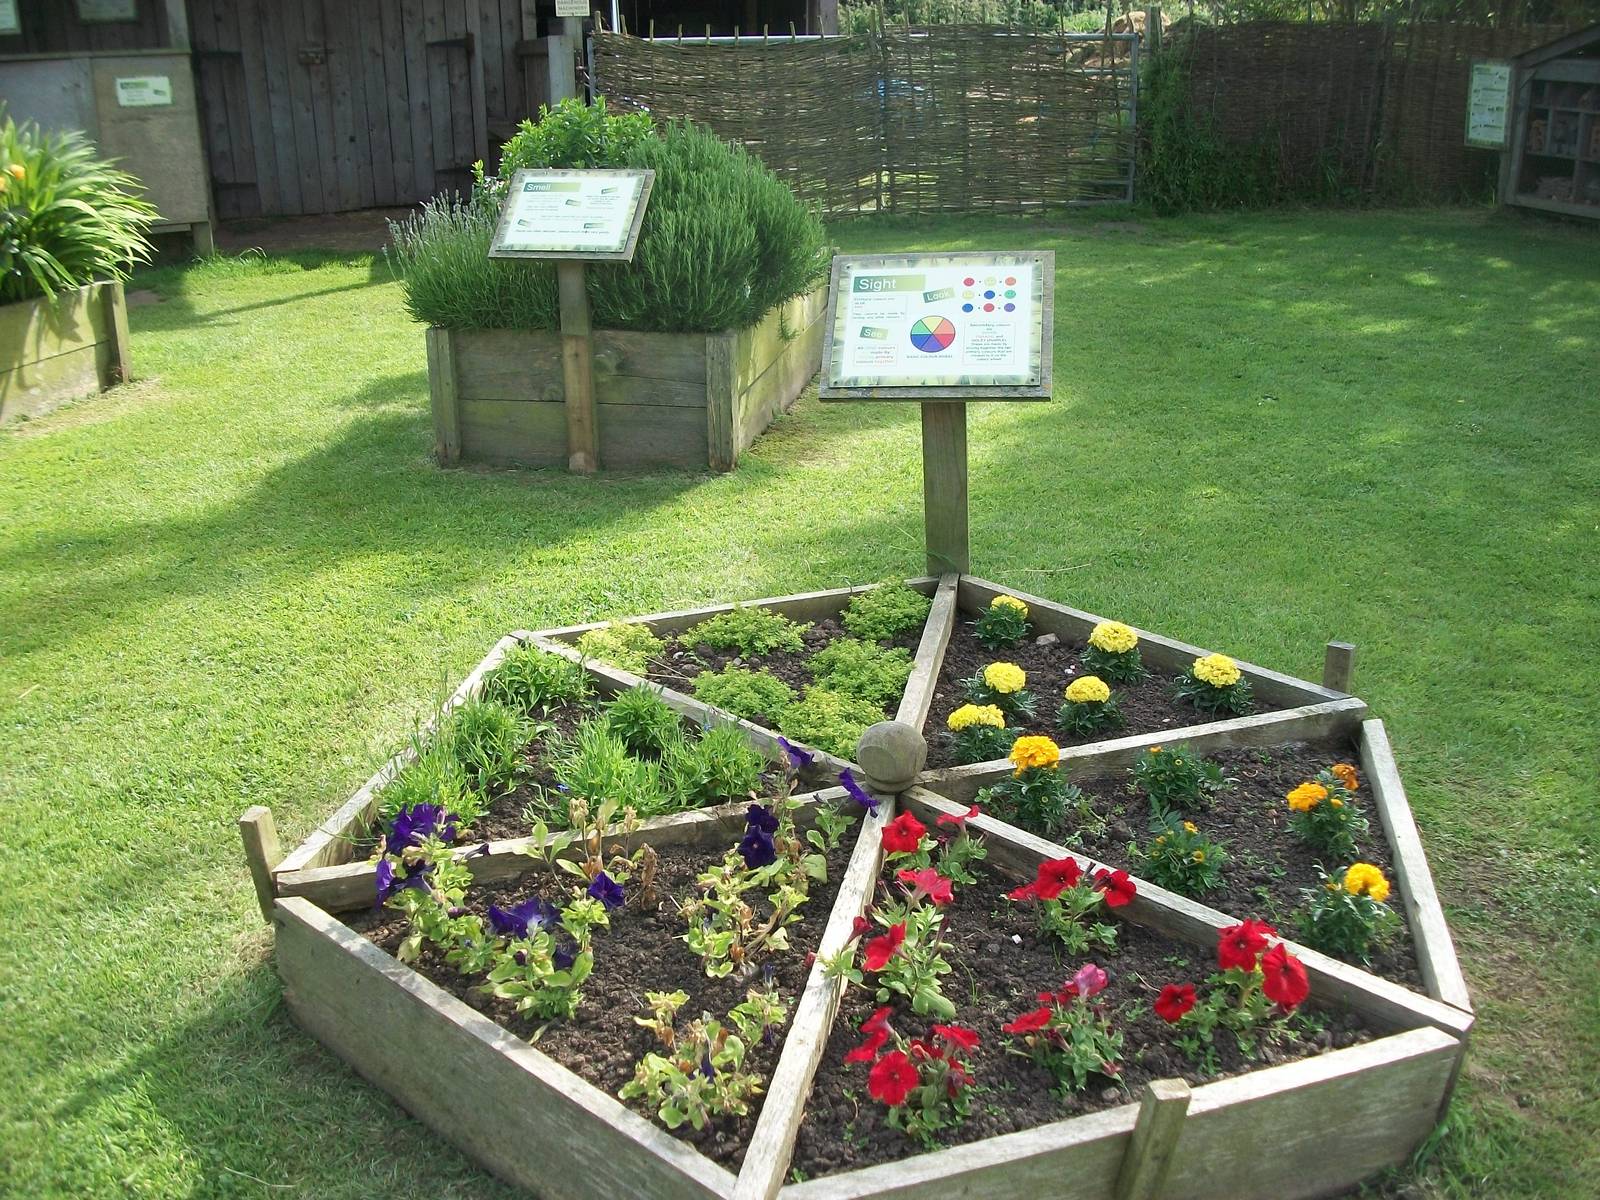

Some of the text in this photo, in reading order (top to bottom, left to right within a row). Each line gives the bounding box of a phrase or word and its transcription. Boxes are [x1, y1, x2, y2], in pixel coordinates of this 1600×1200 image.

[527, 183, 551, 191] Smell
[859, 278, 896, 291] Sight
[927, 289, 950, 301] Look
